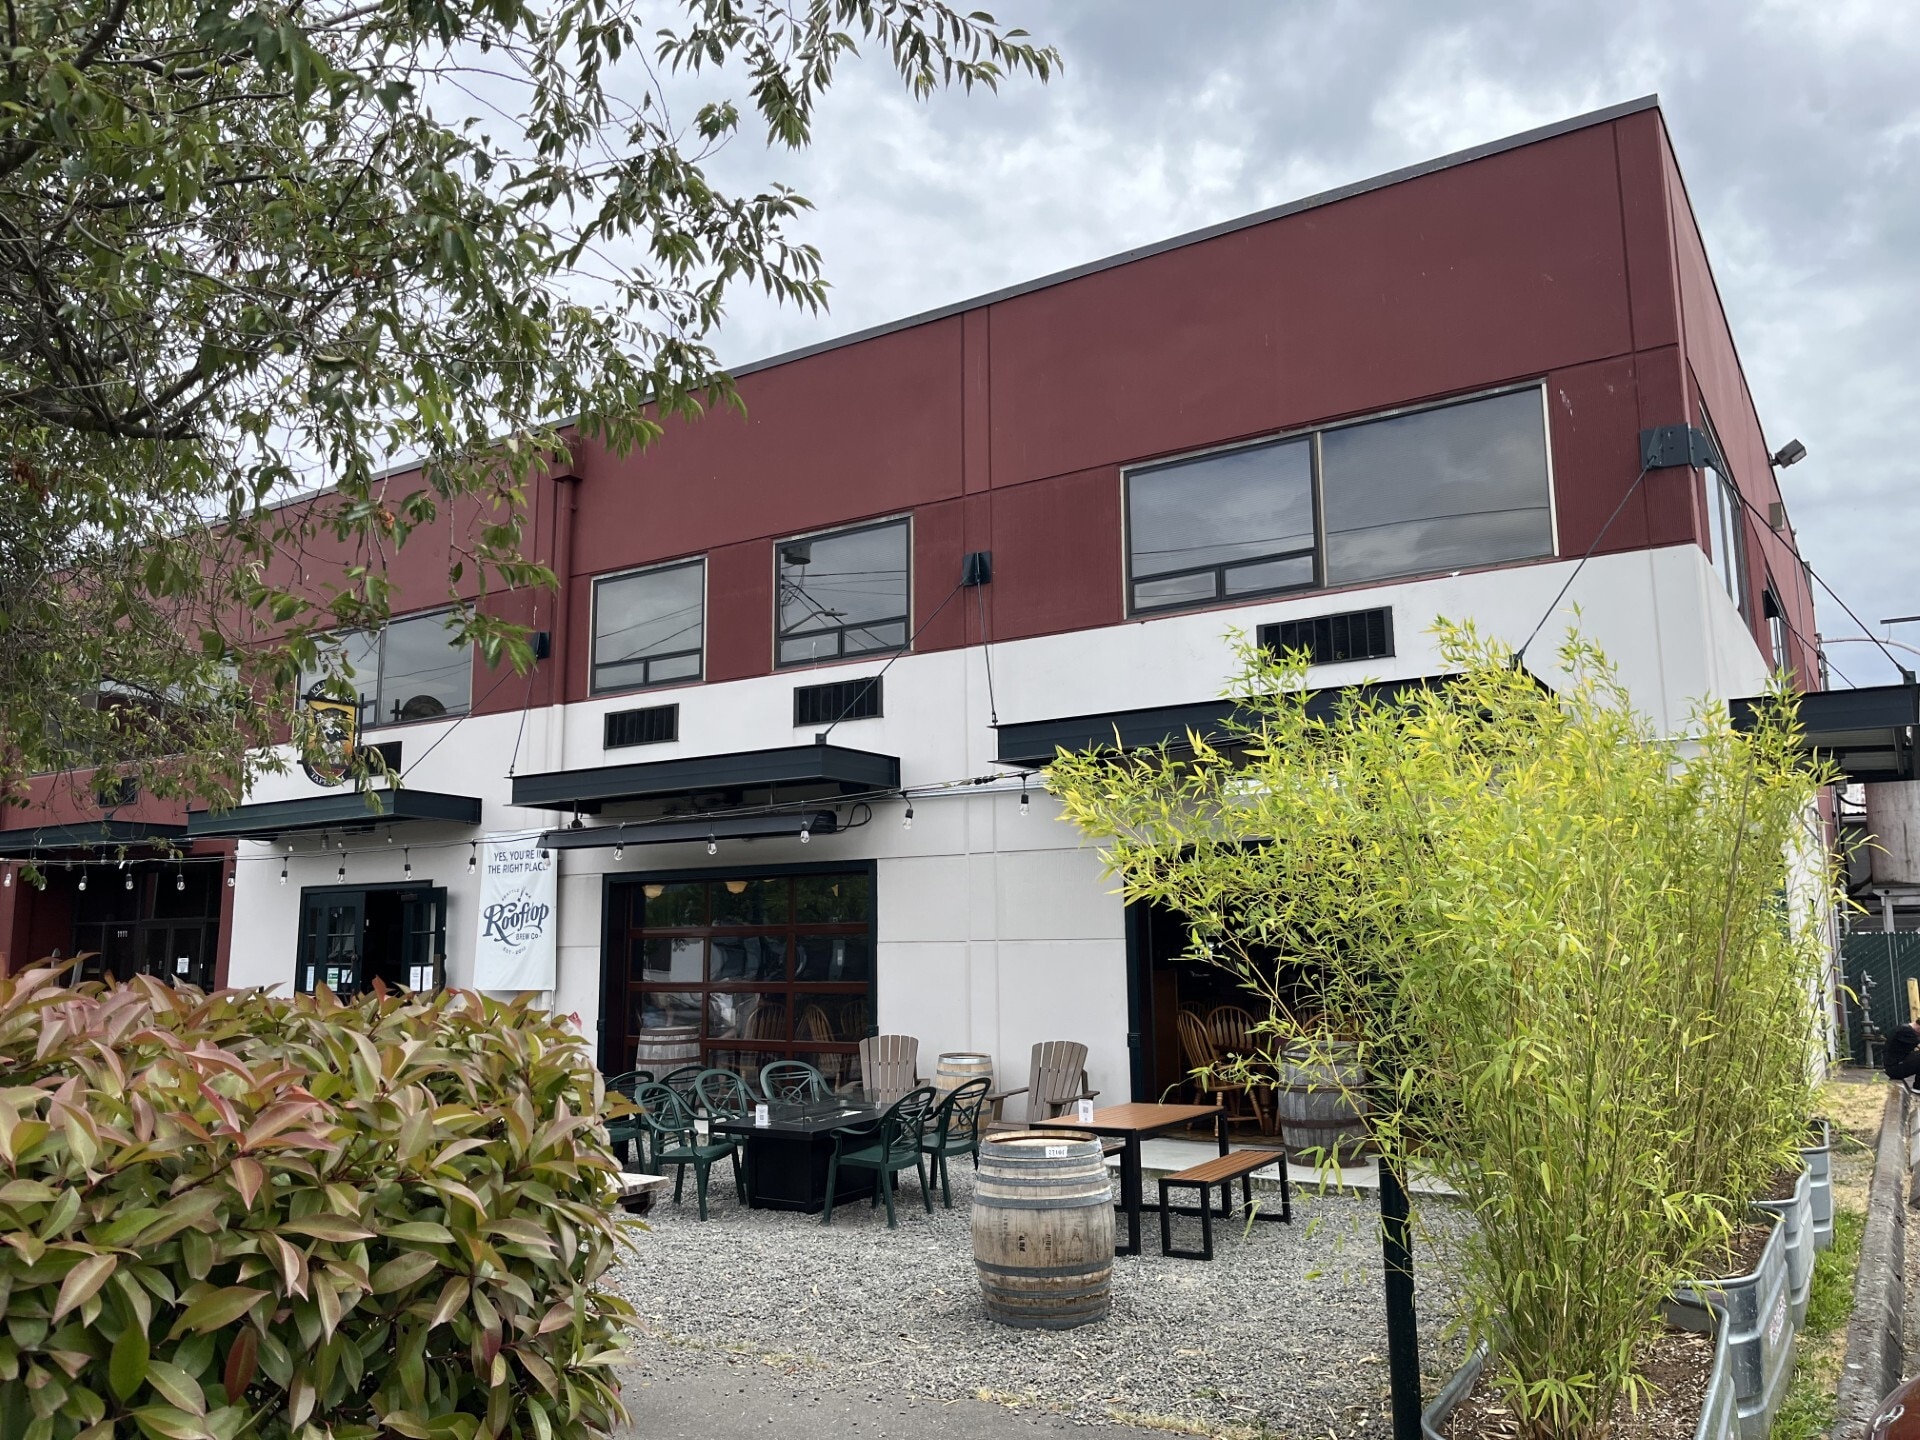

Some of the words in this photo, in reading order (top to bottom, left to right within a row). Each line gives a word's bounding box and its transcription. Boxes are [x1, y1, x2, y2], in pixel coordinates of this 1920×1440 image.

[311, 771, 346, 786] TAPRO
[494, 851, 508, 862] YES,
[510, 849, 535, 860] YOU'RE
[536, 849, 544, 859] IN
[488, 864, 500, 874] THE
[502, 863, 523, 874] RIGHT
[482, 902, 549, 946] Rooftop
